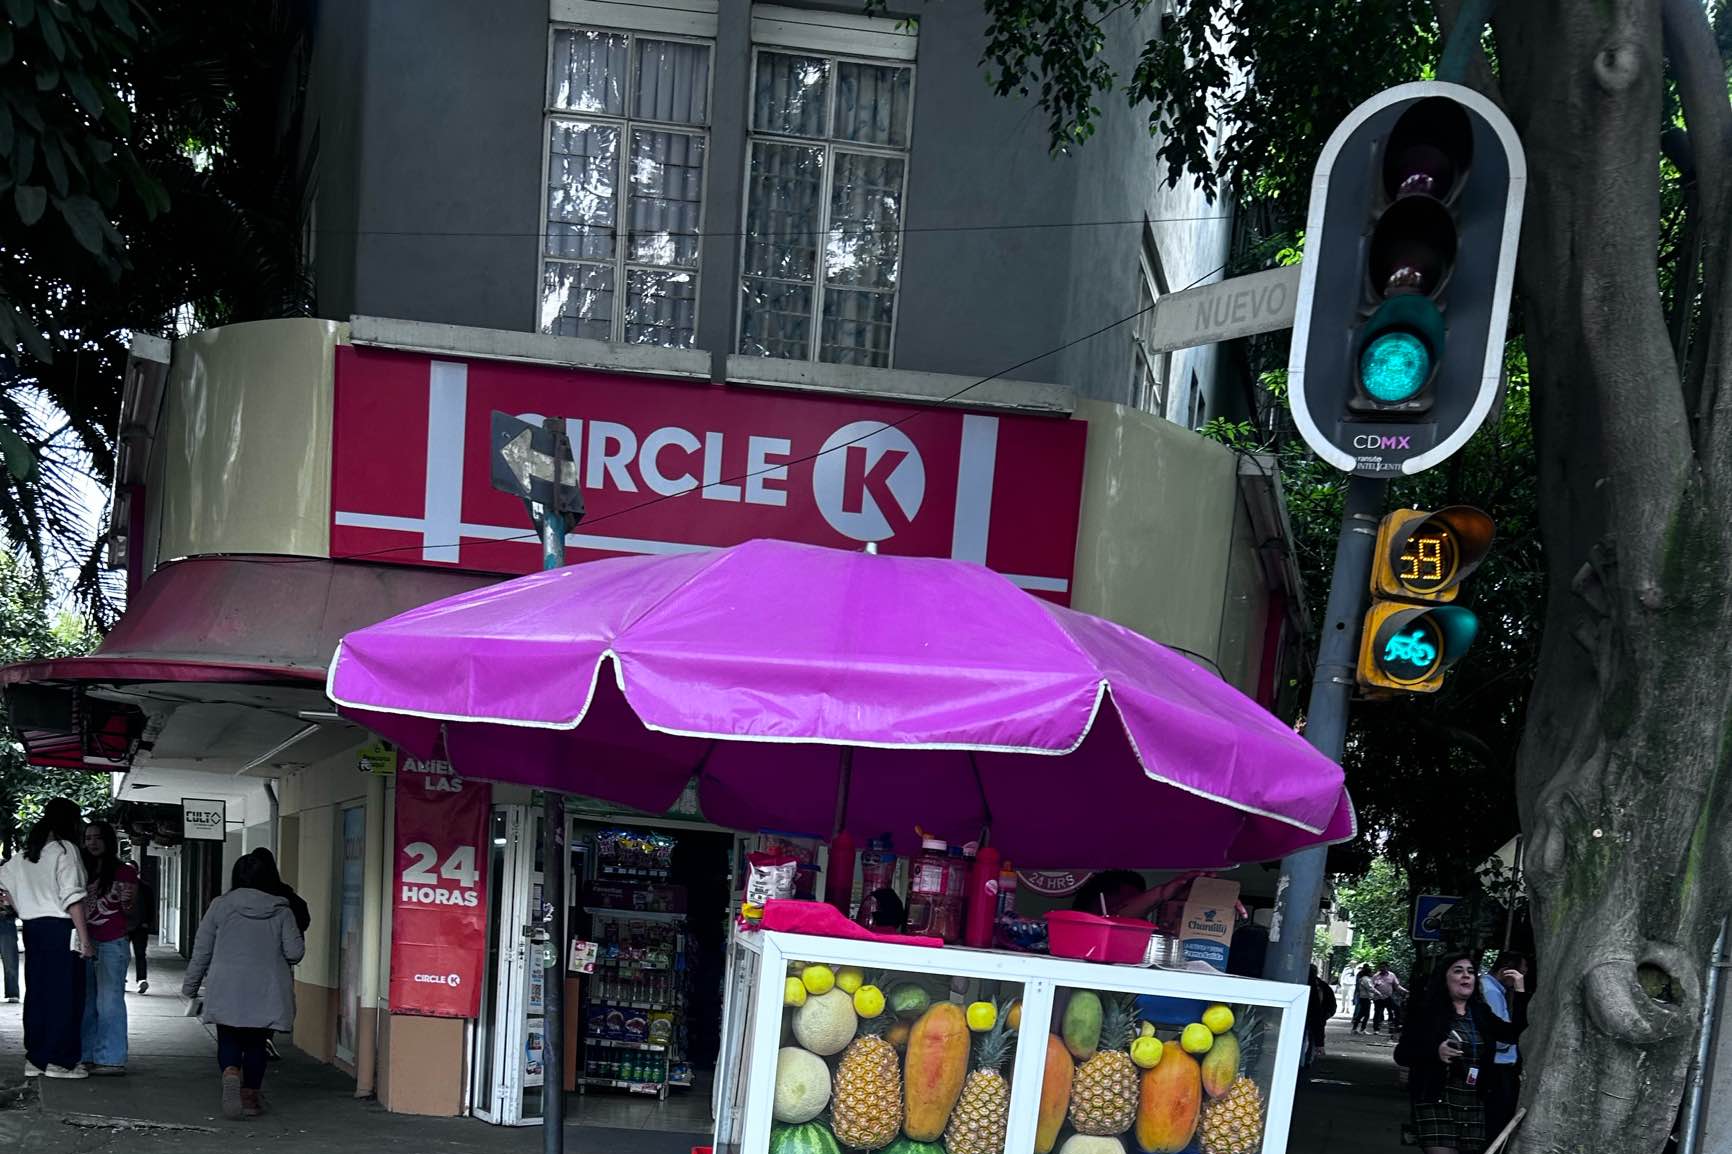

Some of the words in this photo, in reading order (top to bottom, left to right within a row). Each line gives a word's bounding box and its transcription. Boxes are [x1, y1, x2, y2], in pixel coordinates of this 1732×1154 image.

[1194, 282, 1289, 332] NUEVO
[1353, 434, 1411, 450] CDMX
[513, 412, 792, 507] IRCLE
[838, 443, 917, 537] K
[425, 776, 463, 793] LAS
[402, 841, 480, 888] 24
[1031, 872, 1045, 886] 24
[1047, 874, 1076, 889] HRS
[402, 886, 479, 907] HORAS
[415, 973, 447, 984] CIRCLE
